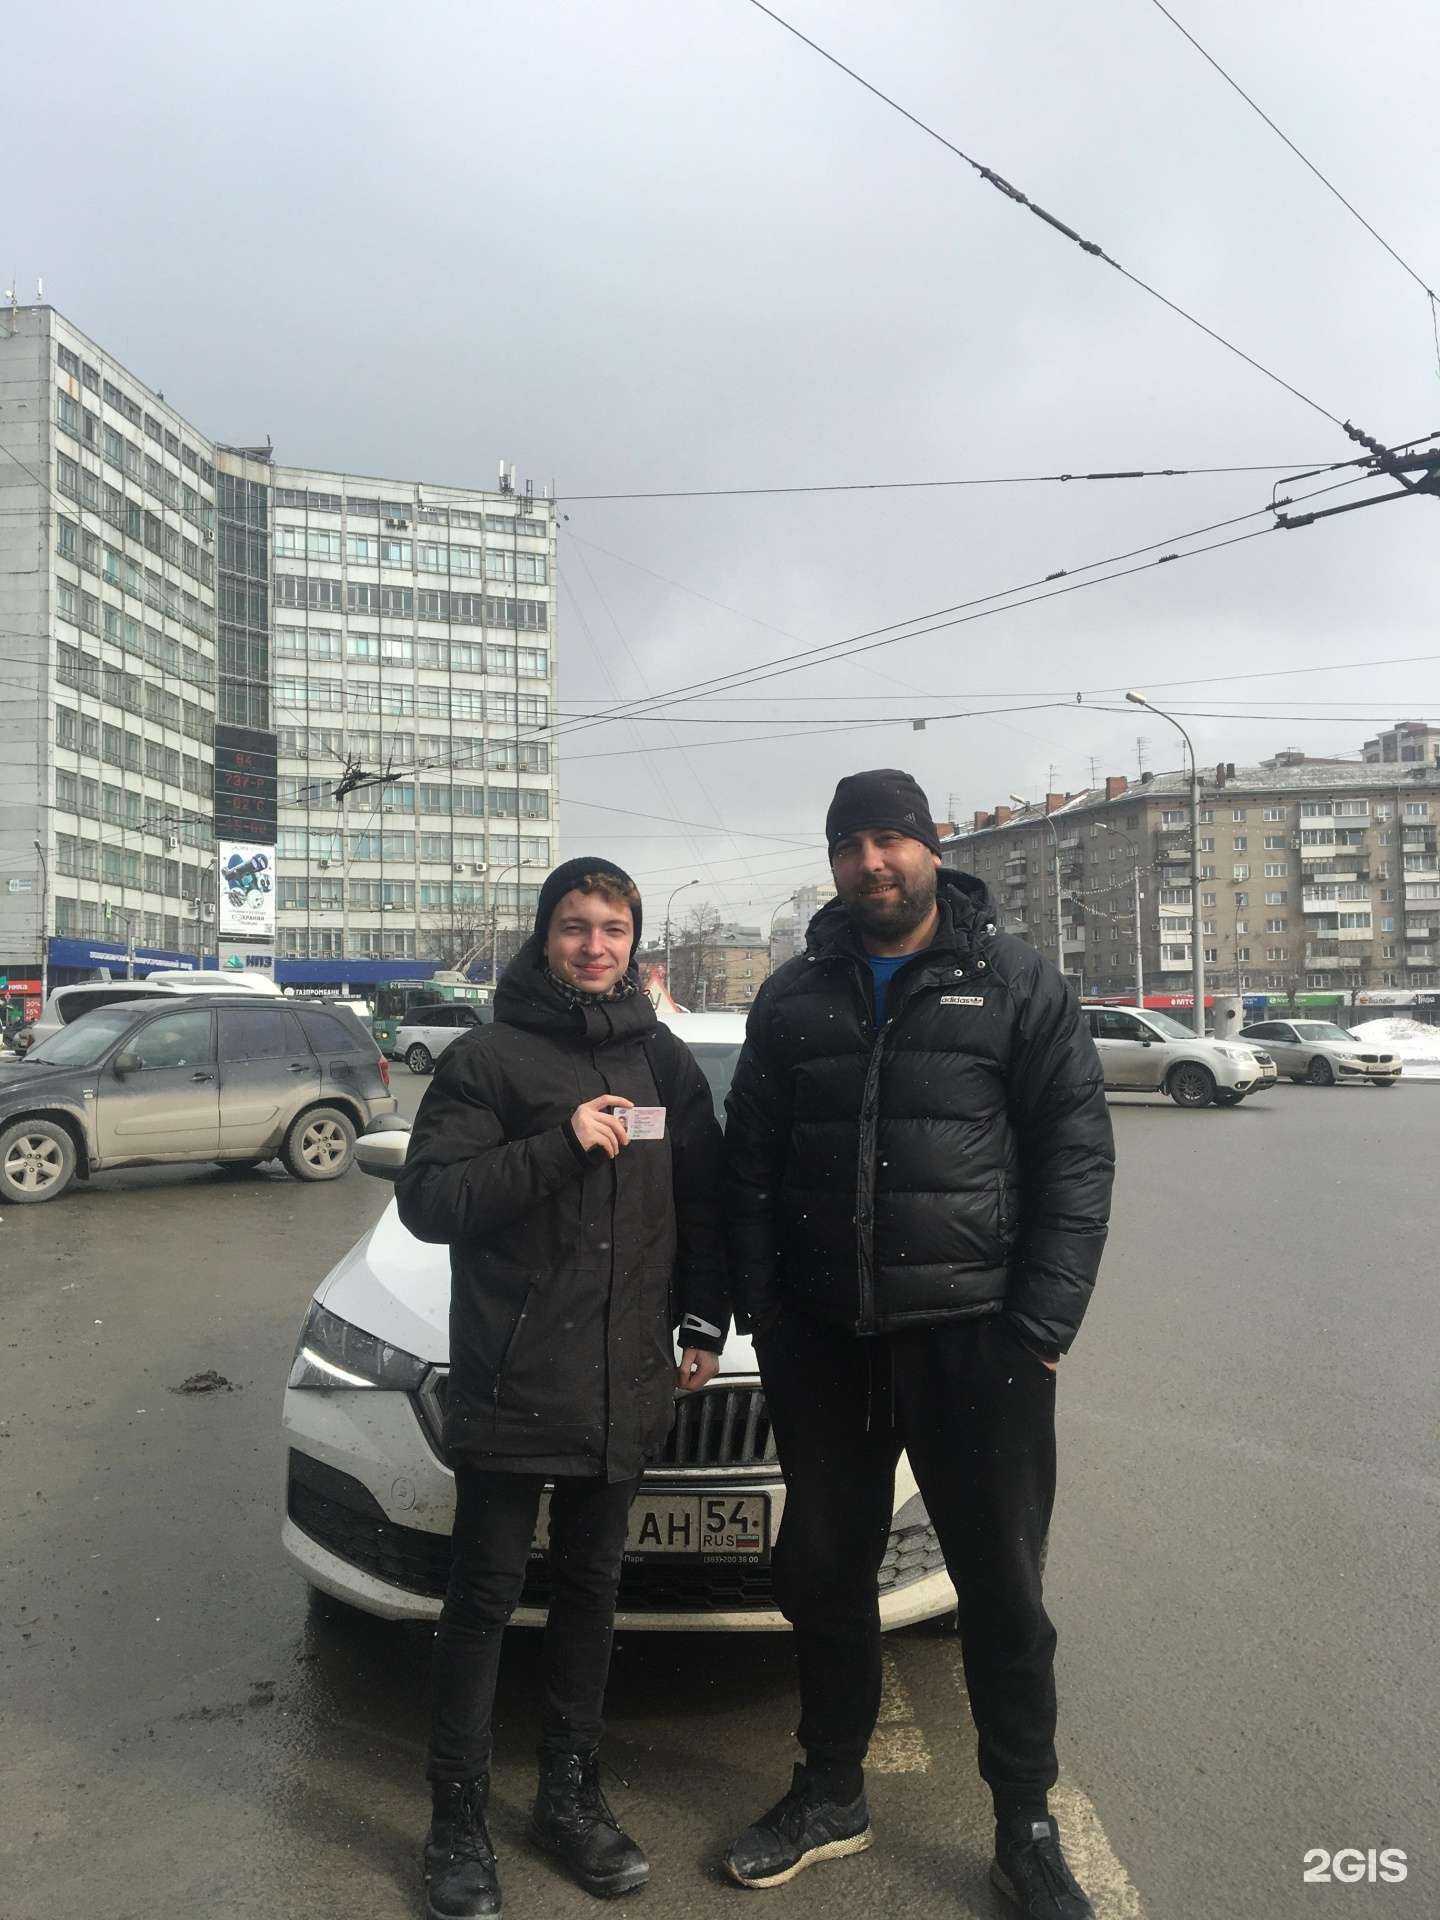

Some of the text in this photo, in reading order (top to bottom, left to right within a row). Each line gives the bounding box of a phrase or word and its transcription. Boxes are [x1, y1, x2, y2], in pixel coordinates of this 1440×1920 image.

[295, 988, 340, 996] ГАЗПРОМБАНК
[941, 996, 970, 1004] adidas
[706, 1501, 749, 1533] 54
[703, 1535, 735, 1547] RUS
